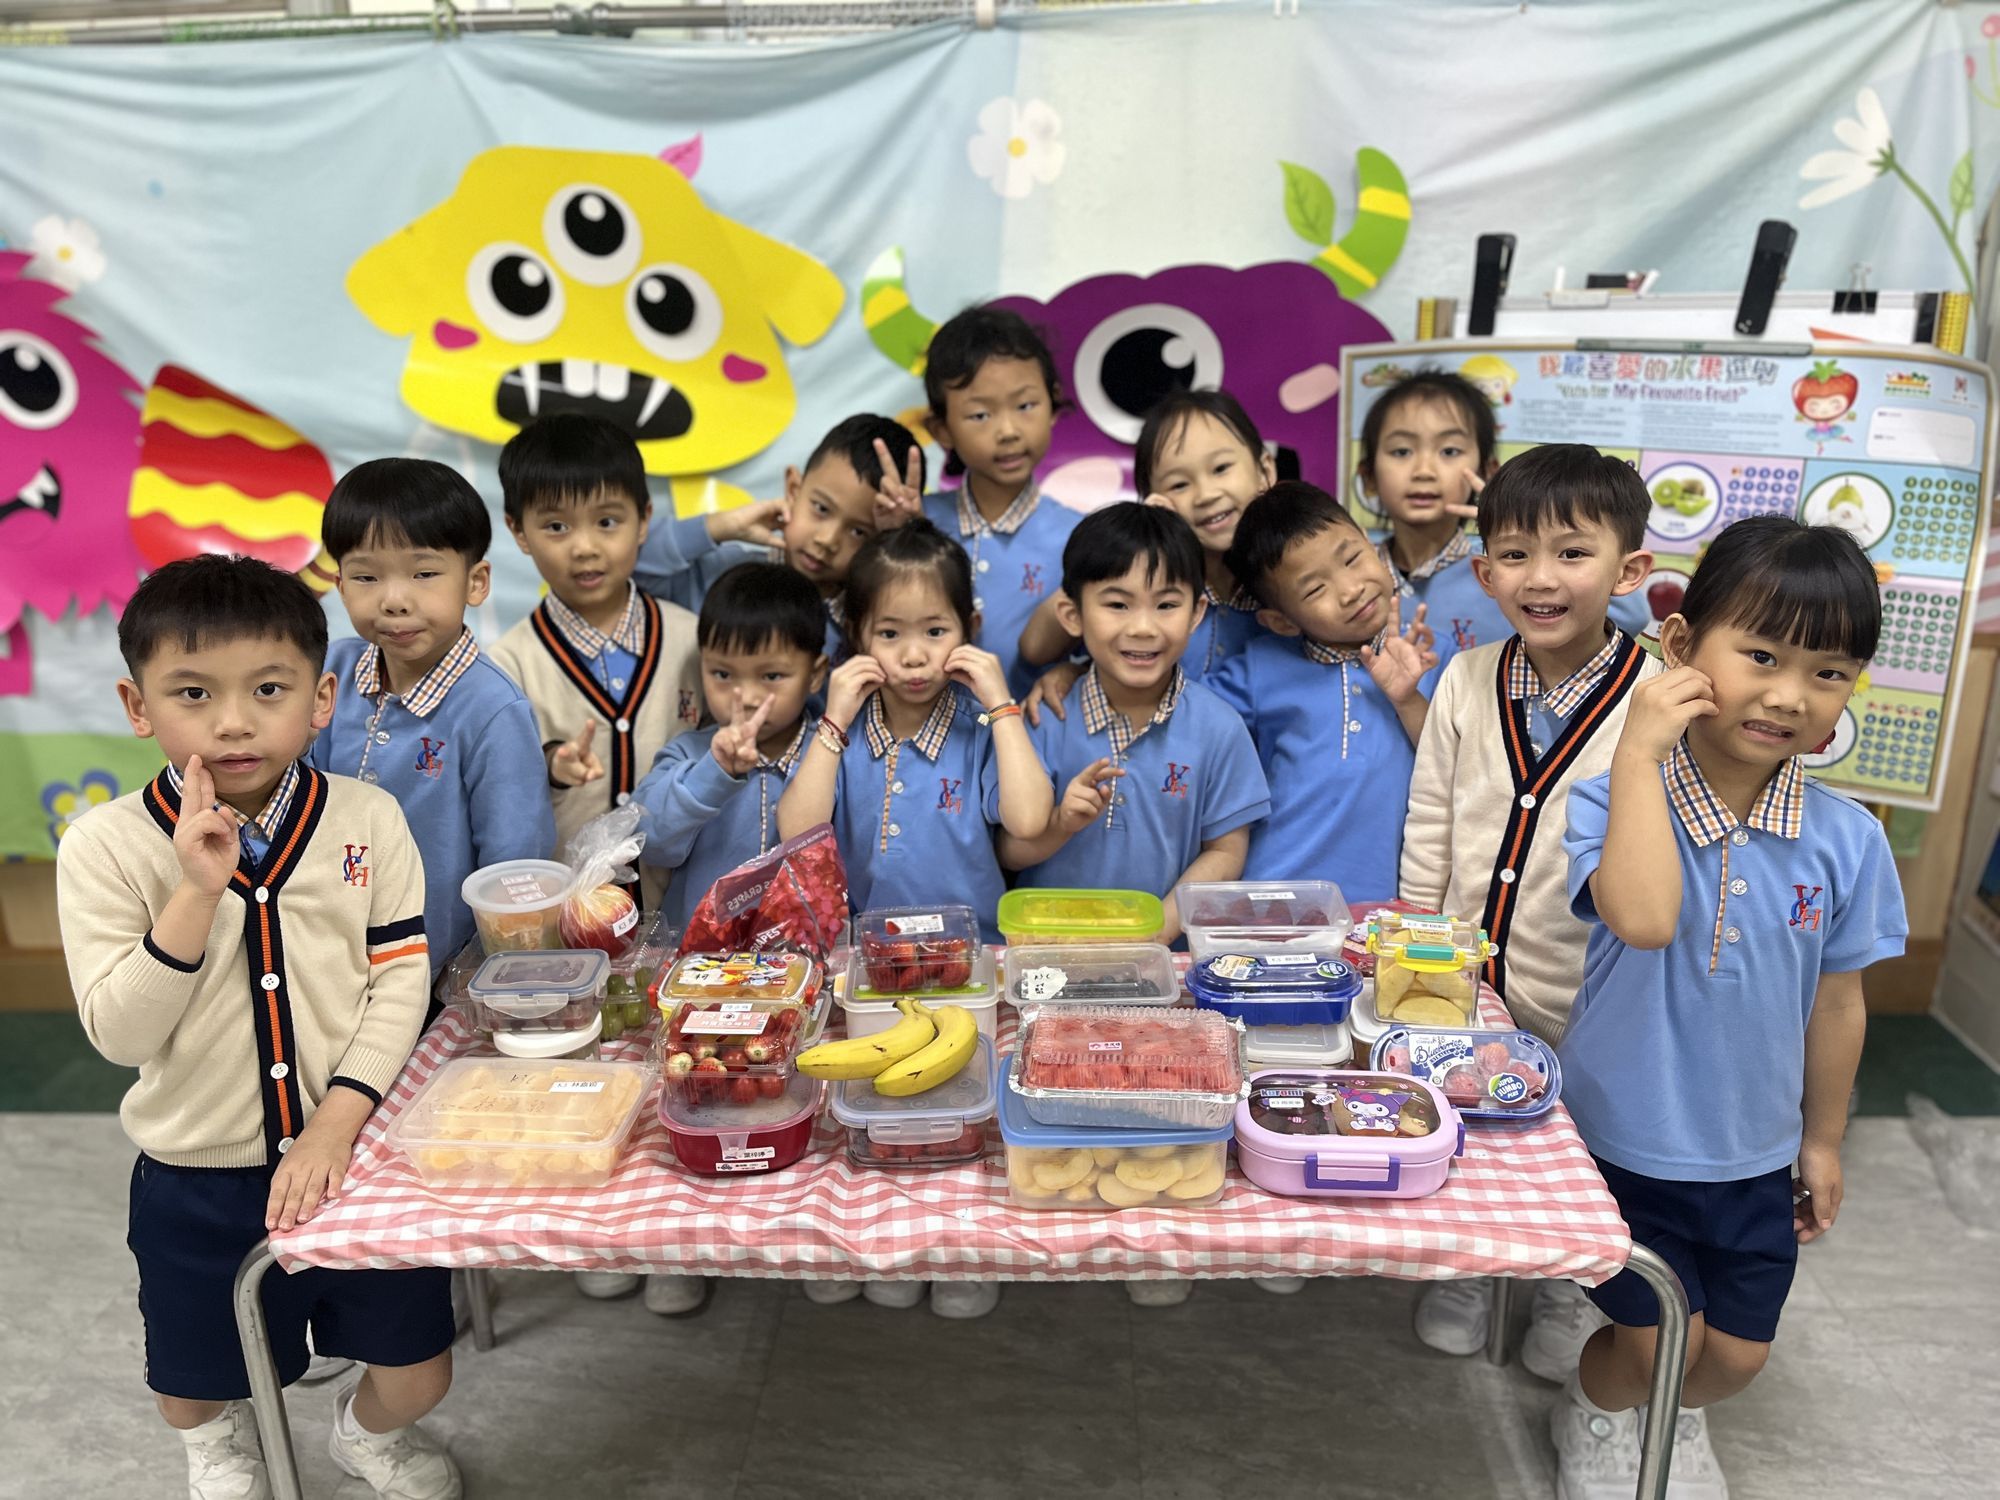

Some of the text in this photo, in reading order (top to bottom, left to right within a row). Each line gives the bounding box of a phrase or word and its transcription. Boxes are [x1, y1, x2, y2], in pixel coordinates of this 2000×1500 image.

[1539, 353, 1778, 385] 我最喜愛的水果選舉
[1614, 384, 1636, 398] My
[1640, 385, 1703, 400] Favourite
[1498, 1076, 1515, 1087] SUPER
[1497, 1082, 1523, 1097] JUMBO
